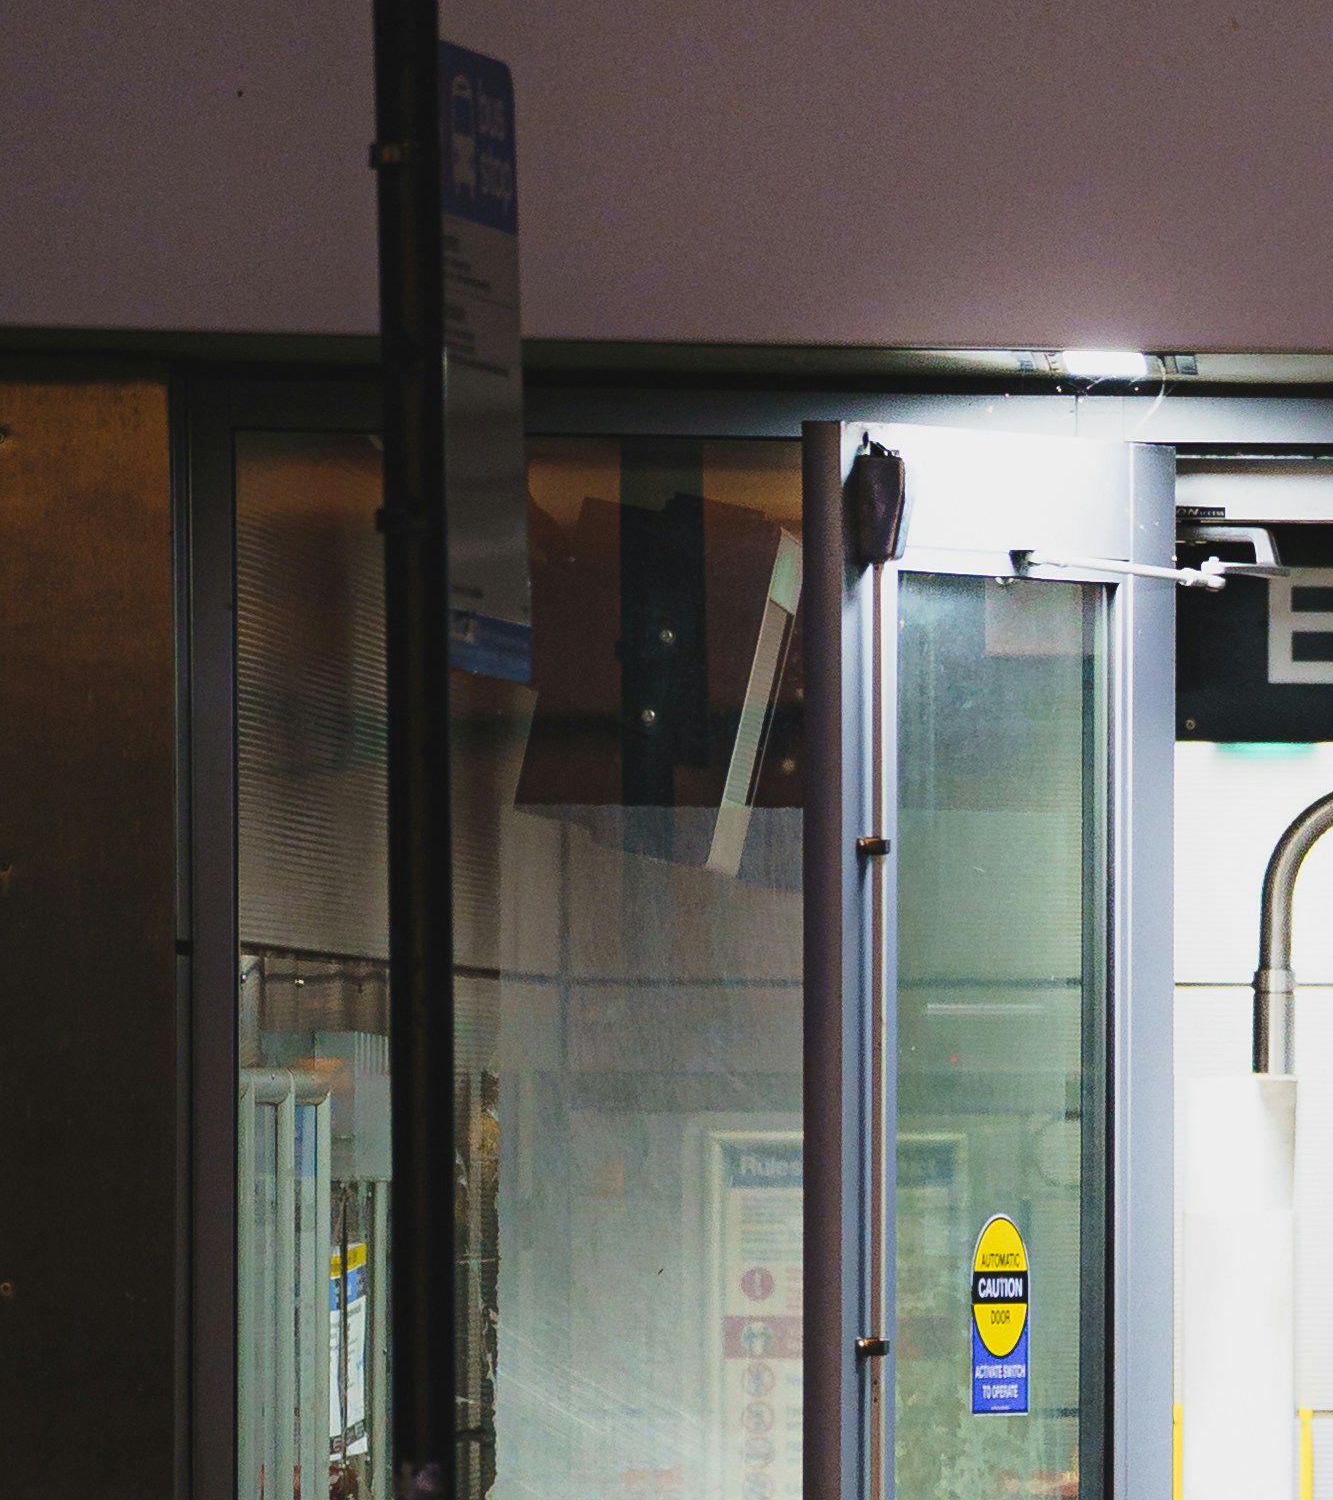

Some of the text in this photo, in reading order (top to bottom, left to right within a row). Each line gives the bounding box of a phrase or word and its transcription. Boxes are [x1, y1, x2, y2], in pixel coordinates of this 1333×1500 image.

[981, 1253, 1020, 1268] AUTOMATIC
[978, 1277, 1023, 1298] CAUTION
[990, 1310, 1011, 1324] DOOR
[975, 1365, 1026, 1378] ACTIVATE SWITCH
[982, 1385, 1019, 1399] TO OPERATE
